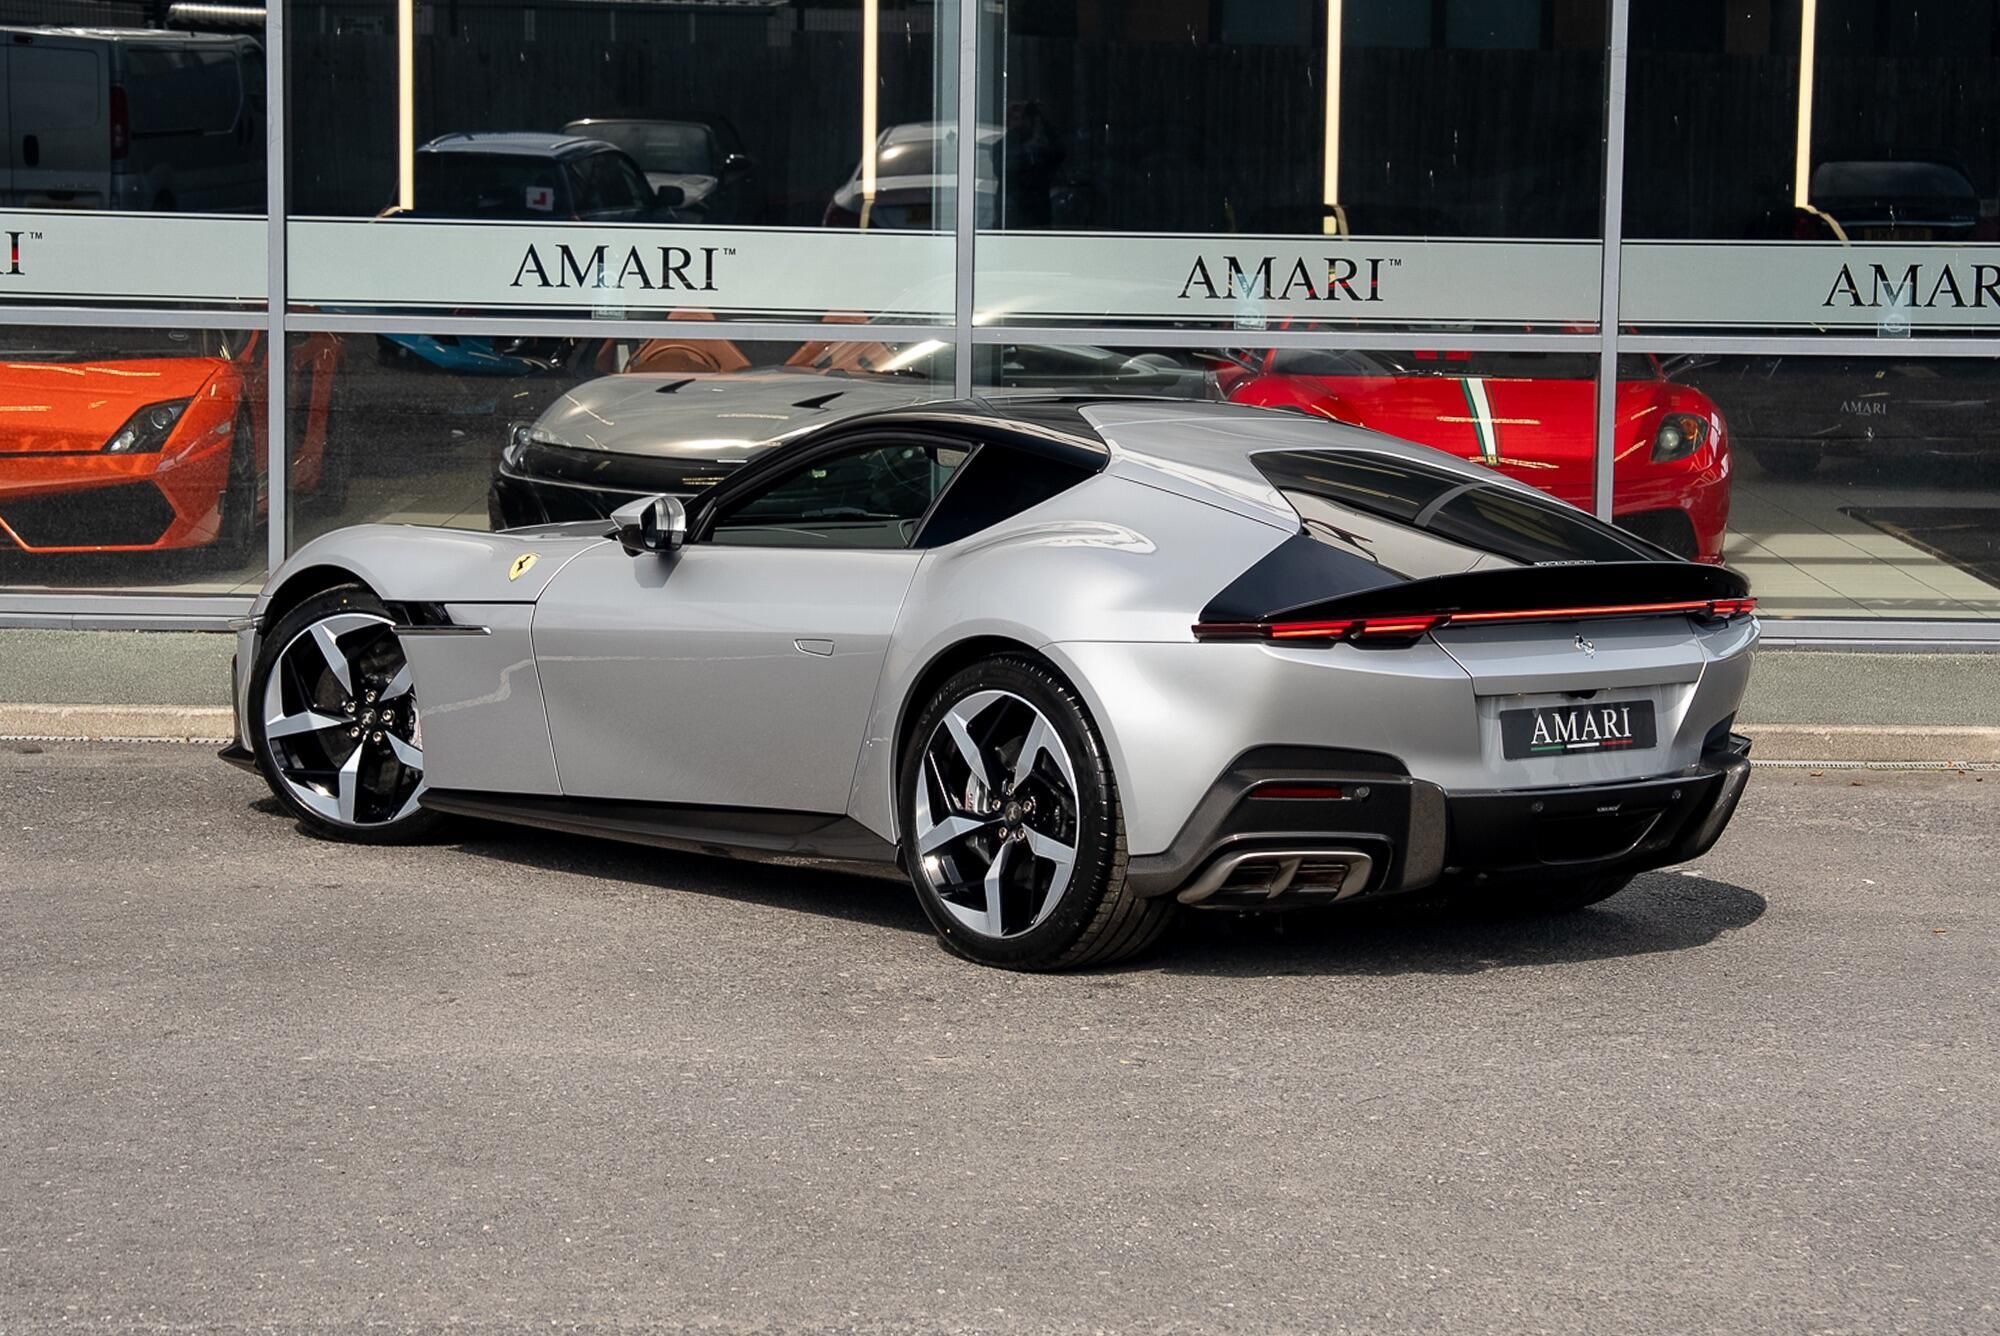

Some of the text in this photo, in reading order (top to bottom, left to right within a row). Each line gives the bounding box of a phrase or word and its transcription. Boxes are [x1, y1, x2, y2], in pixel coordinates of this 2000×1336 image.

[510, 243, 719, 291] AMARI
[1177, 255, 1385, 301] AMARI
[1840, 400, 1887, 415] AMARI
[1530, 707, 1633, 745] AMARI
